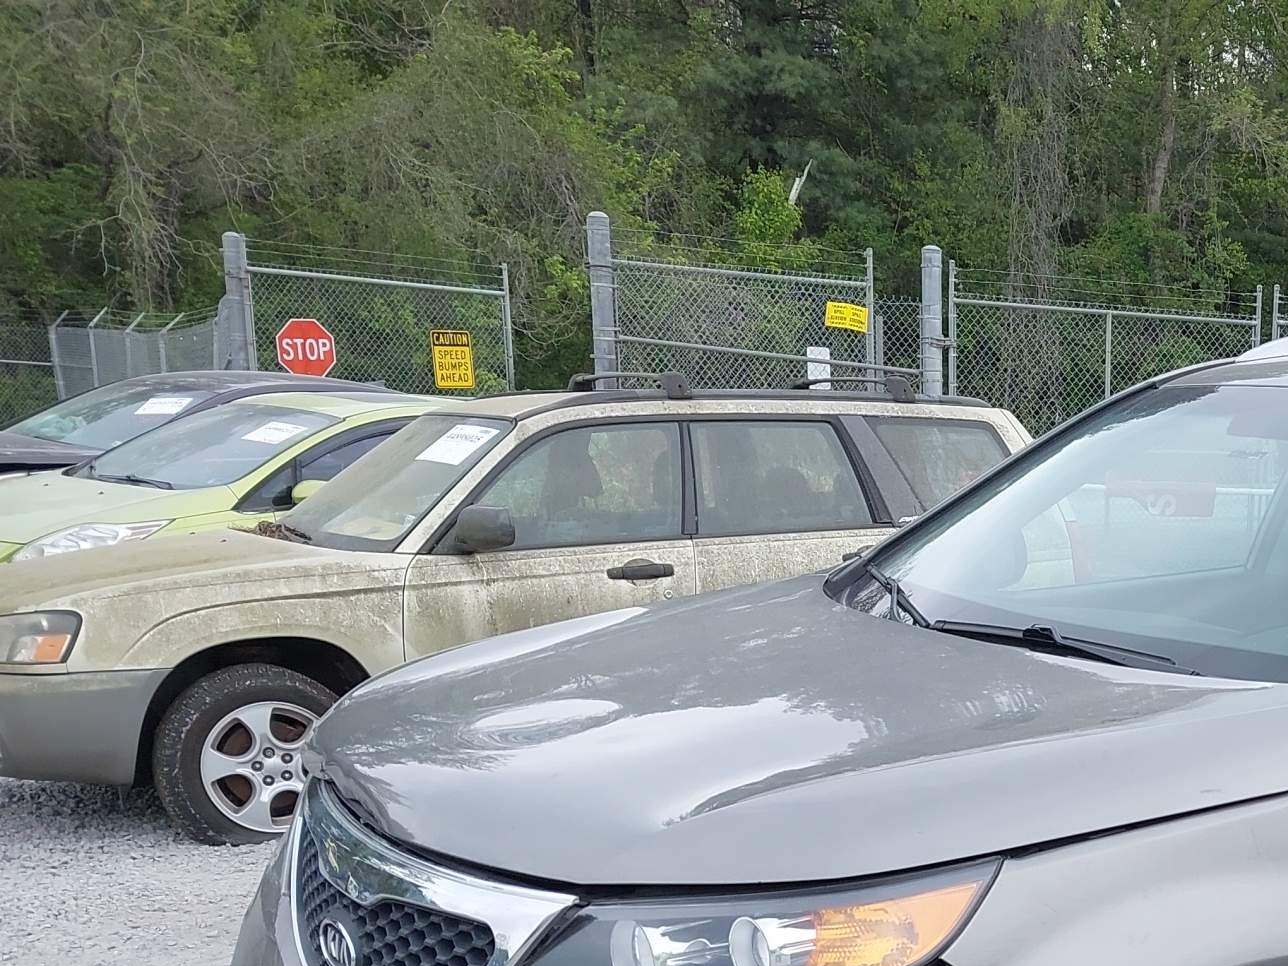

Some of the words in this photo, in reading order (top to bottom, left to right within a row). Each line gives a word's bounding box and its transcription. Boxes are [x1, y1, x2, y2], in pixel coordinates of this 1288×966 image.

[433, 333, 469, 345] CAUTION
[282, 338, 331, 360] STOP
[438, 350, 466, 360] SPEED
[438, 361, 469, 371] BUMPS
[440, 372, 469, 383] AHEAD
